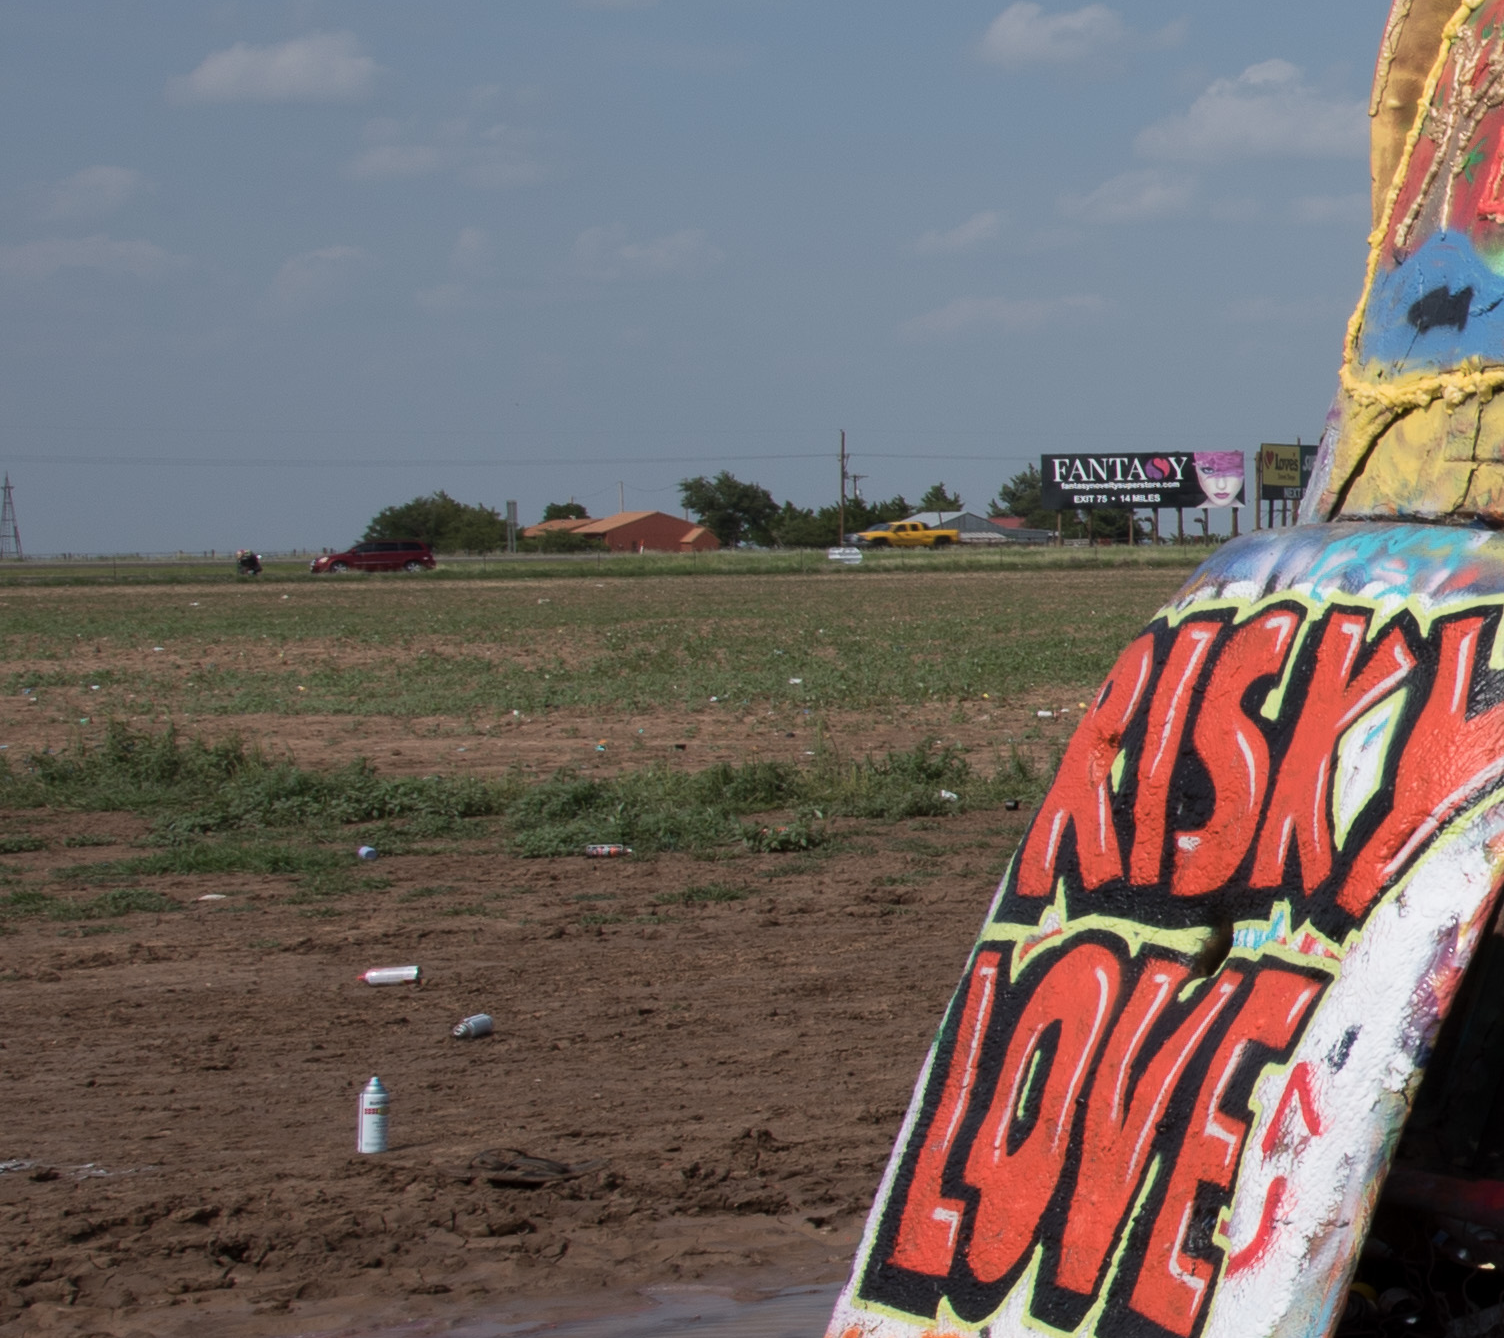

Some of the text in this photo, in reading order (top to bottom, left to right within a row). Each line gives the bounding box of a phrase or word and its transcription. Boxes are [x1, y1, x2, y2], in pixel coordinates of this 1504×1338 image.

[1073, 493, 1161, 503] EXIT 75 14 MILES
